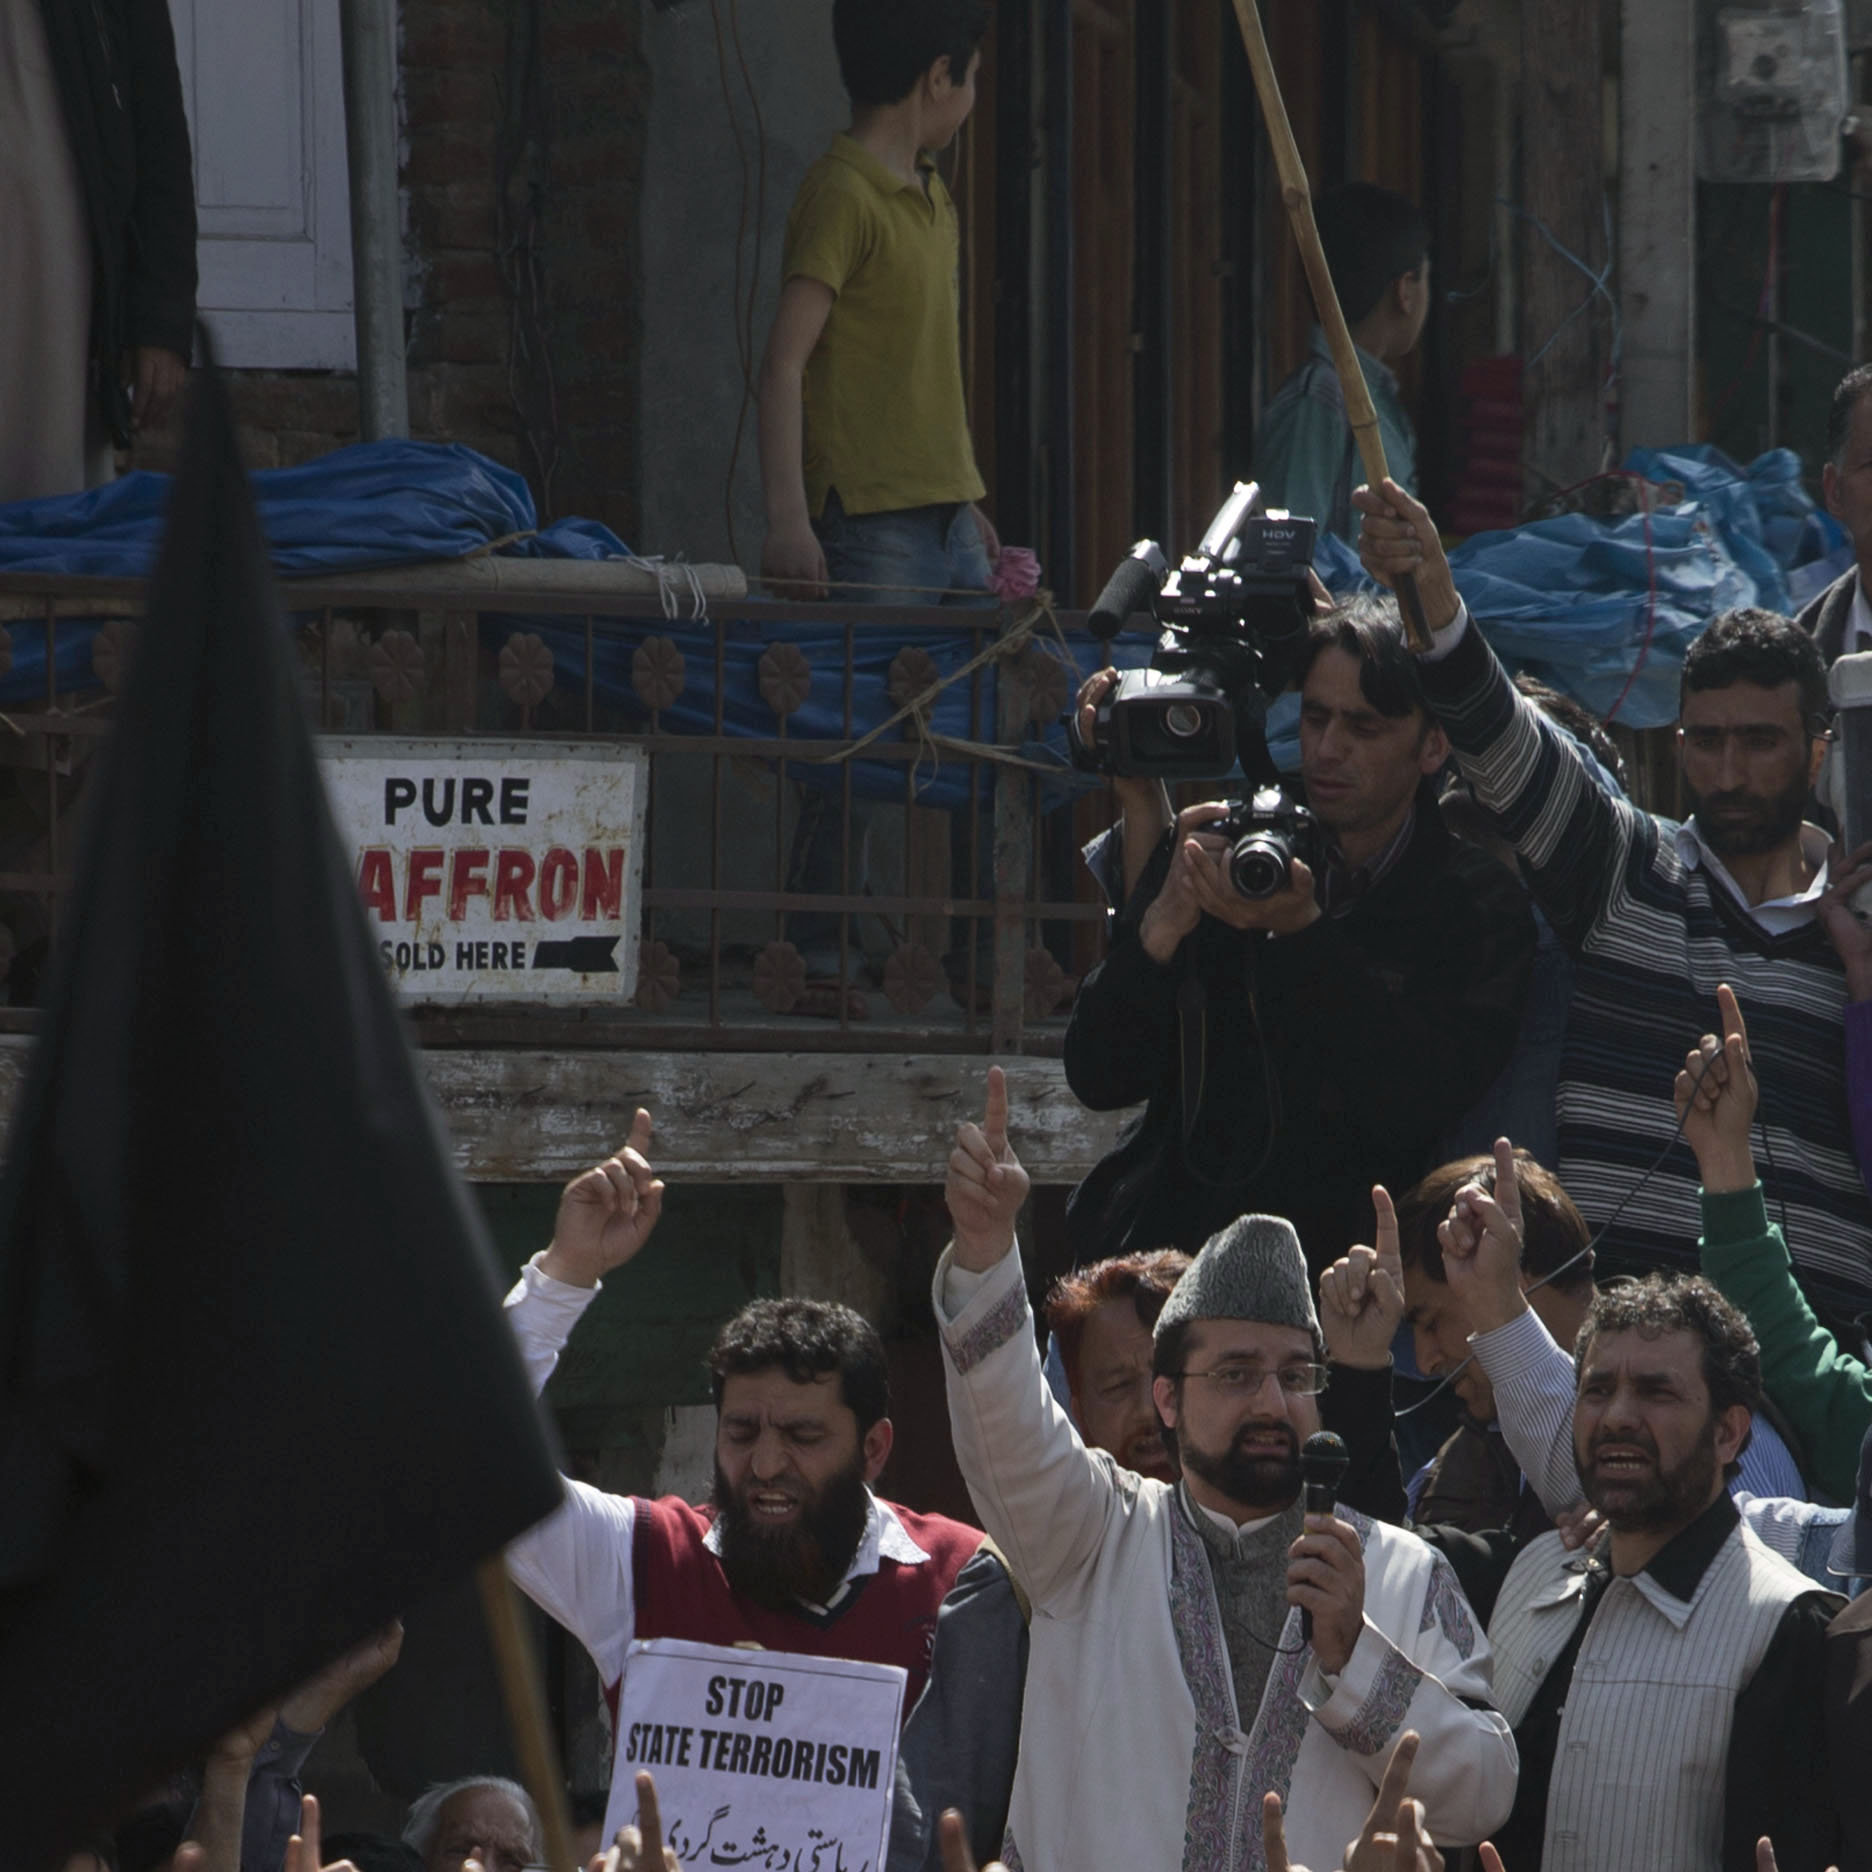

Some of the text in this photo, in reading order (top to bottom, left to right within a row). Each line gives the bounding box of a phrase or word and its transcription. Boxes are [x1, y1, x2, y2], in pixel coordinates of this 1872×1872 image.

[384, 777, 531, 827] PURE
[357, 845, 626, 923] AFFRON
[381, 939, 526, 971] SOLD HERE
[705, 1675, 784, 1723] STOP
[626, 1722, 881, 1790] STATE TERRORISM
